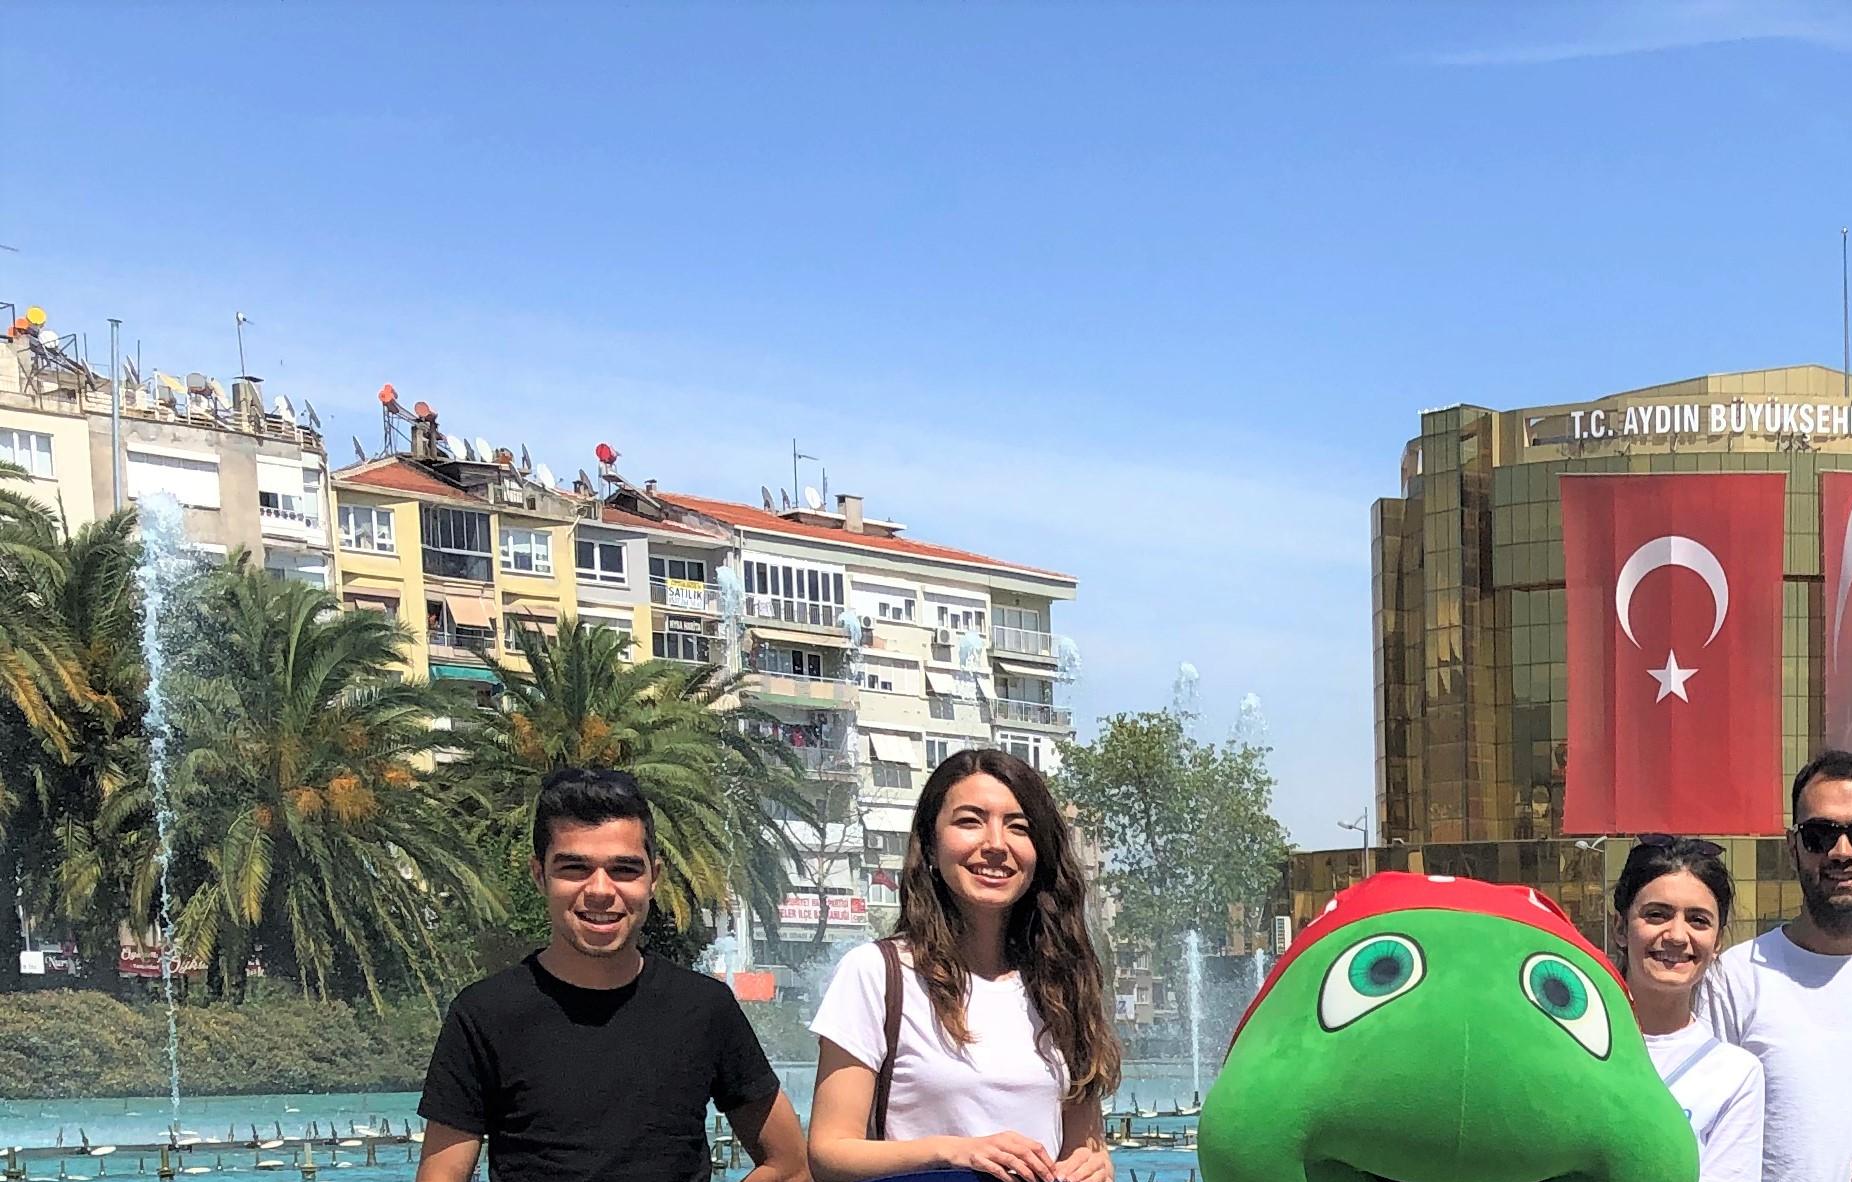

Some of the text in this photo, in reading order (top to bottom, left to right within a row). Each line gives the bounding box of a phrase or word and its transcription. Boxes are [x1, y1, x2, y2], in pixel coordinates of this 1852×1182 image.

[1571, 410, 1614, 439] T.C.
[1623, 404, 1699, 434] AYDIN
[668, 586, 703, 601] SATILIK
